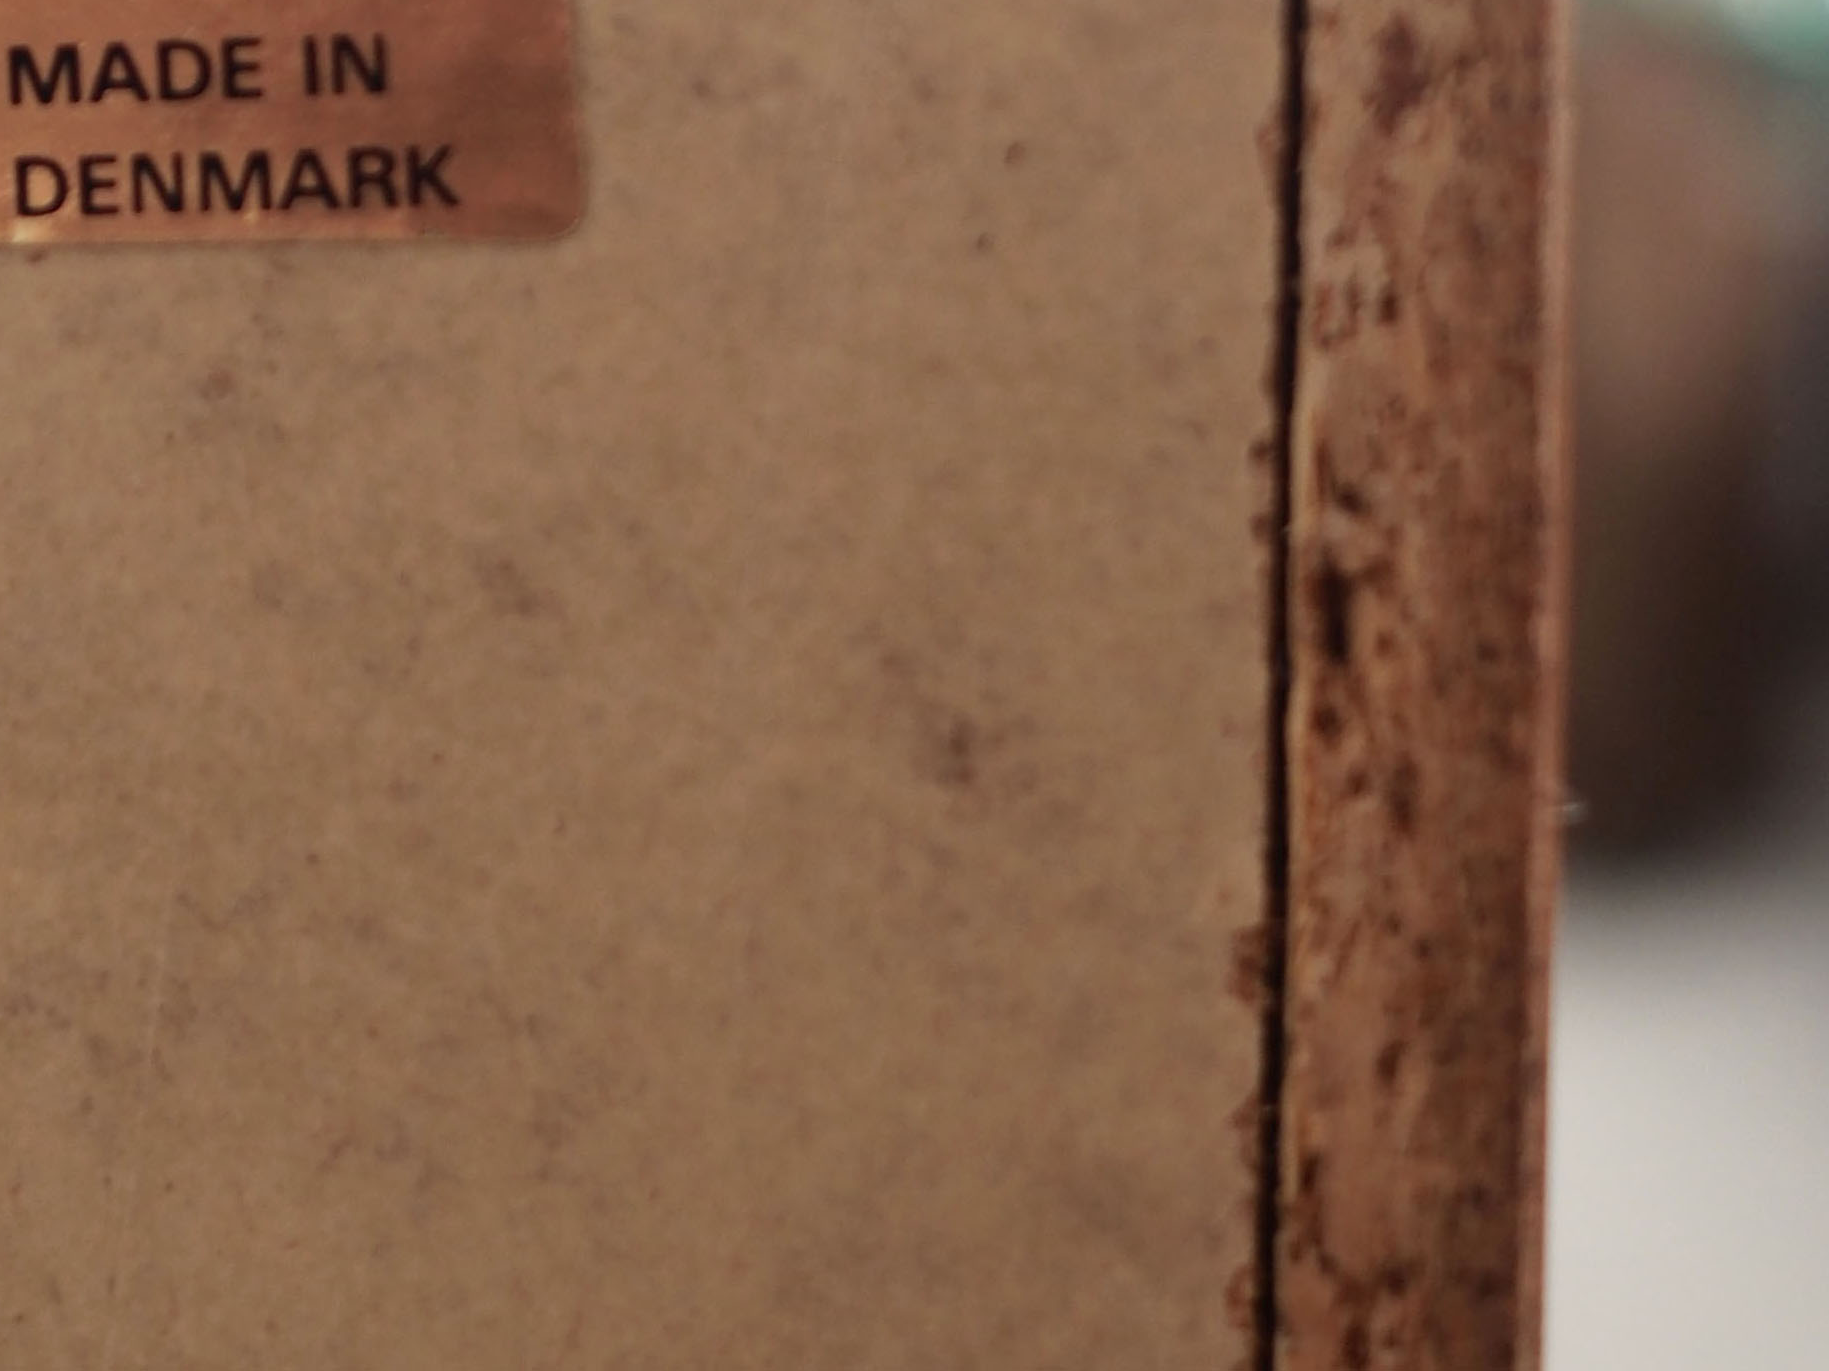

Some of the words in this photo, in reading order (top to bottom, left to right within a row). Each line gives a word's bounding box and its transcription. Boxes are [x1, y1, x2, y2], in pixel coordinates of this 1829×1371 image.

[6, 37, 265, 106] MADE
[302, 32, 388, 97] IN
[13, 144, 461, 217] DENMARK
